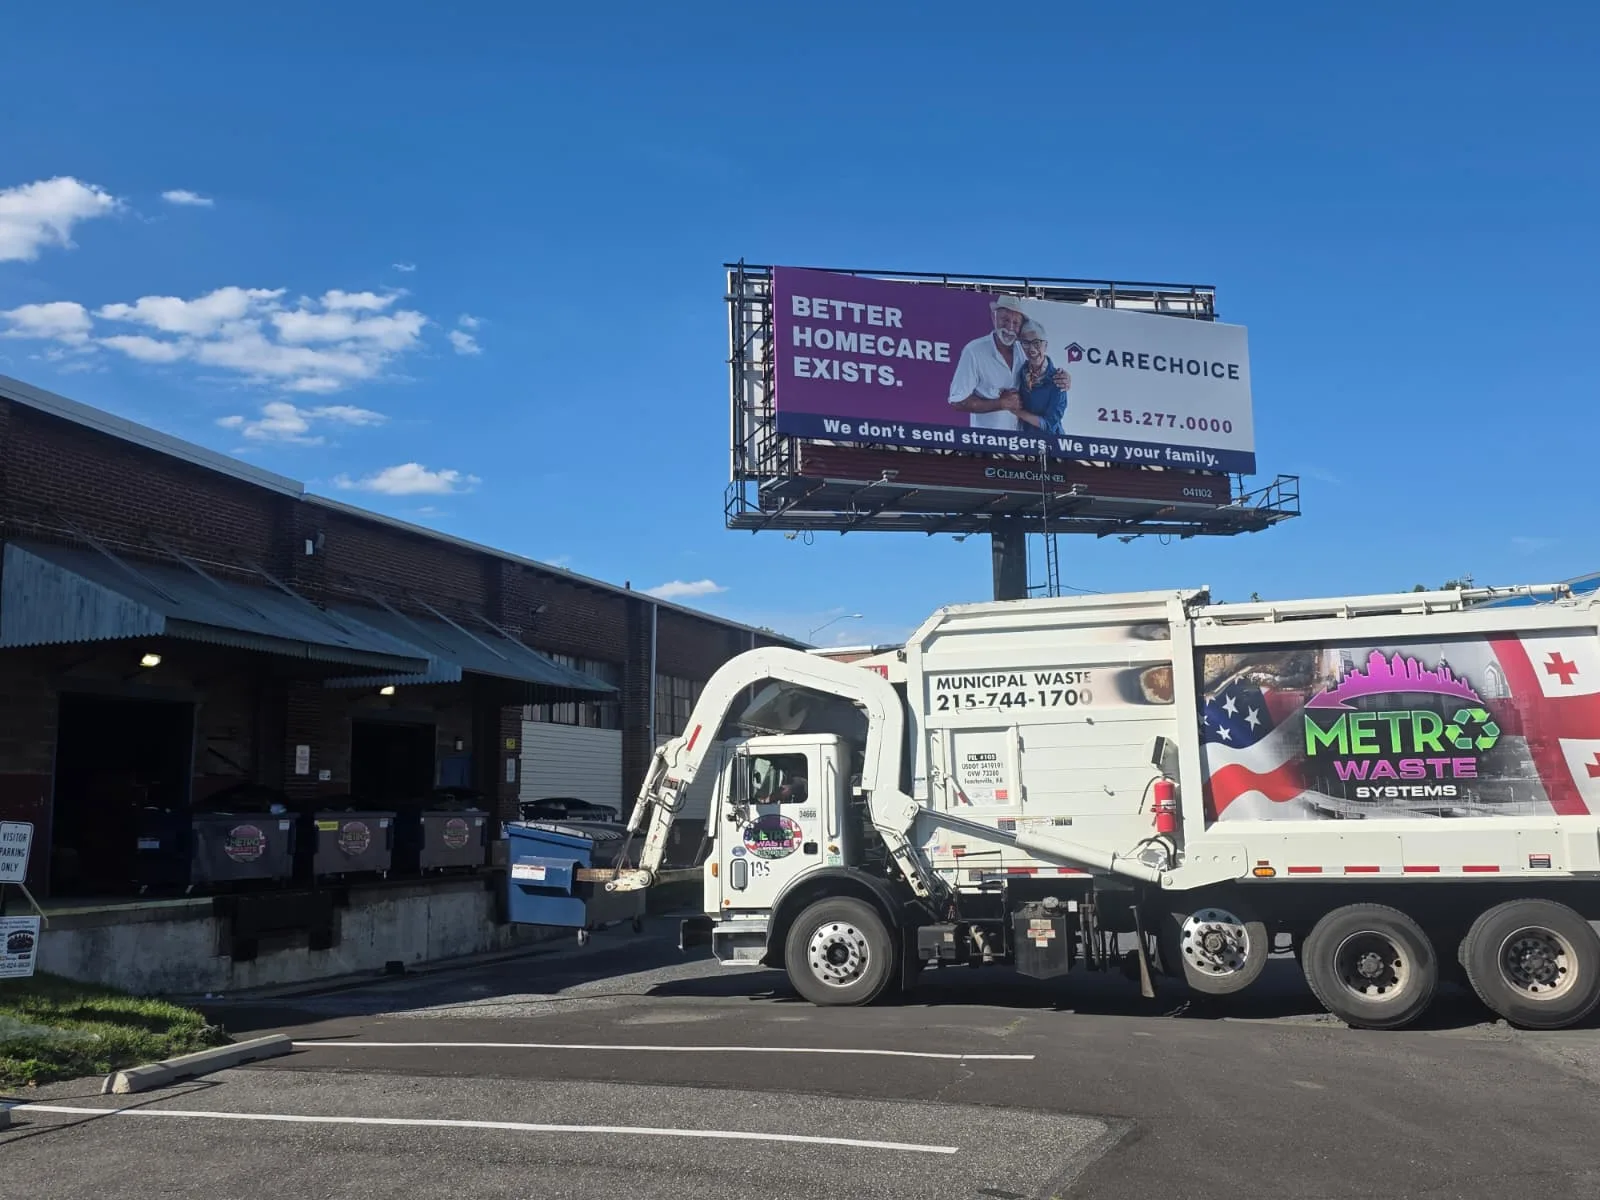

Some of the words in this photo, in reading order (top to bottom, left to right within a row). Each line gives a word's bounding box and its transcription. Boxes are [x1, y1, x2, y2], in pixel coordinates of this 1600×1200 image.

[791, 295, 903, 328] BETTER
[792, 325, 951, 363] HOMECARE
[793, 356, 903, 387] EXISTS.
[1086, 347, 1240, 380] CARECHOICE
[1097, 407, 1233, 434] 215.277.0000
[823, 419, 852, 434] We
[858, 422, 906, 438] don't
[911, 428, 955, 443] send
[1057, 438, 1084, 452] We
[1089, 444, 1118, 458] pay
[1124, 446, 1160, 459] your
[1165, 447, 1219, 467] family.
[1183, 487, 1213, 498] 041102
[936, 673, 1027, 690] MUNICIPAL
[1034, 671, 1092, 686] WASTE
[936, 688, 1093, 711] 215-744-1700
[1333, 757, 1478, 781] WASTE
[1356, 785, 1457, 799] SYSTEMS
[3, 832, 27, 842] VISITOR
[1, 862, 19, 873] ONLY
